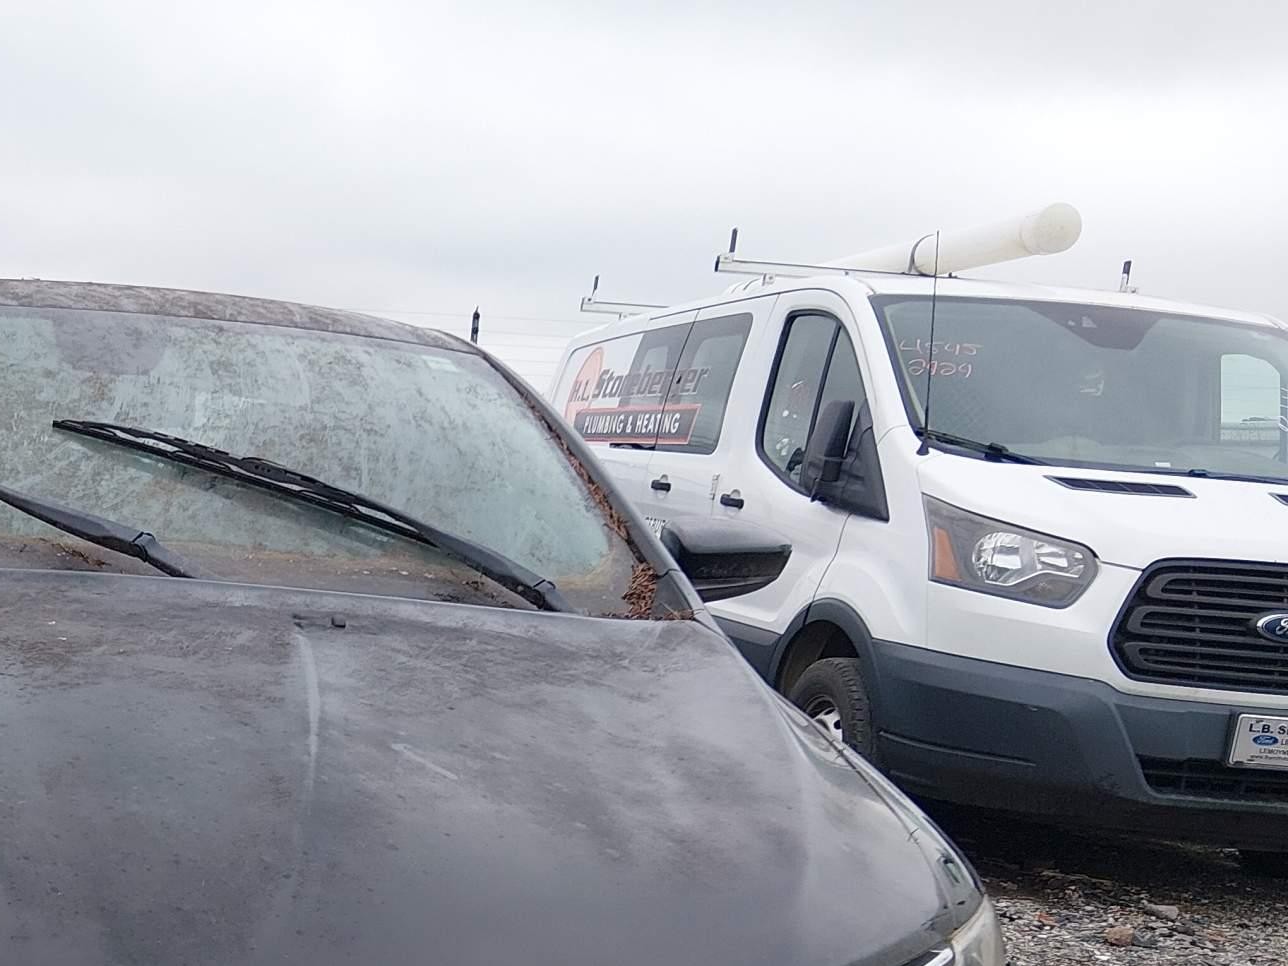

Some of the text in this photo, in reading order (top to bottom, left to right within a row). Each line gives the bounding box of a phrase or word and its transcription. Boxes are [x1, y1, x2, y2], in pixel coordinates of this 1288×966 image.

[625, 415, 633, 433] &
[634, 412, 681, 434] HEATING
[1249, 723, 1274, 734] L.B.
